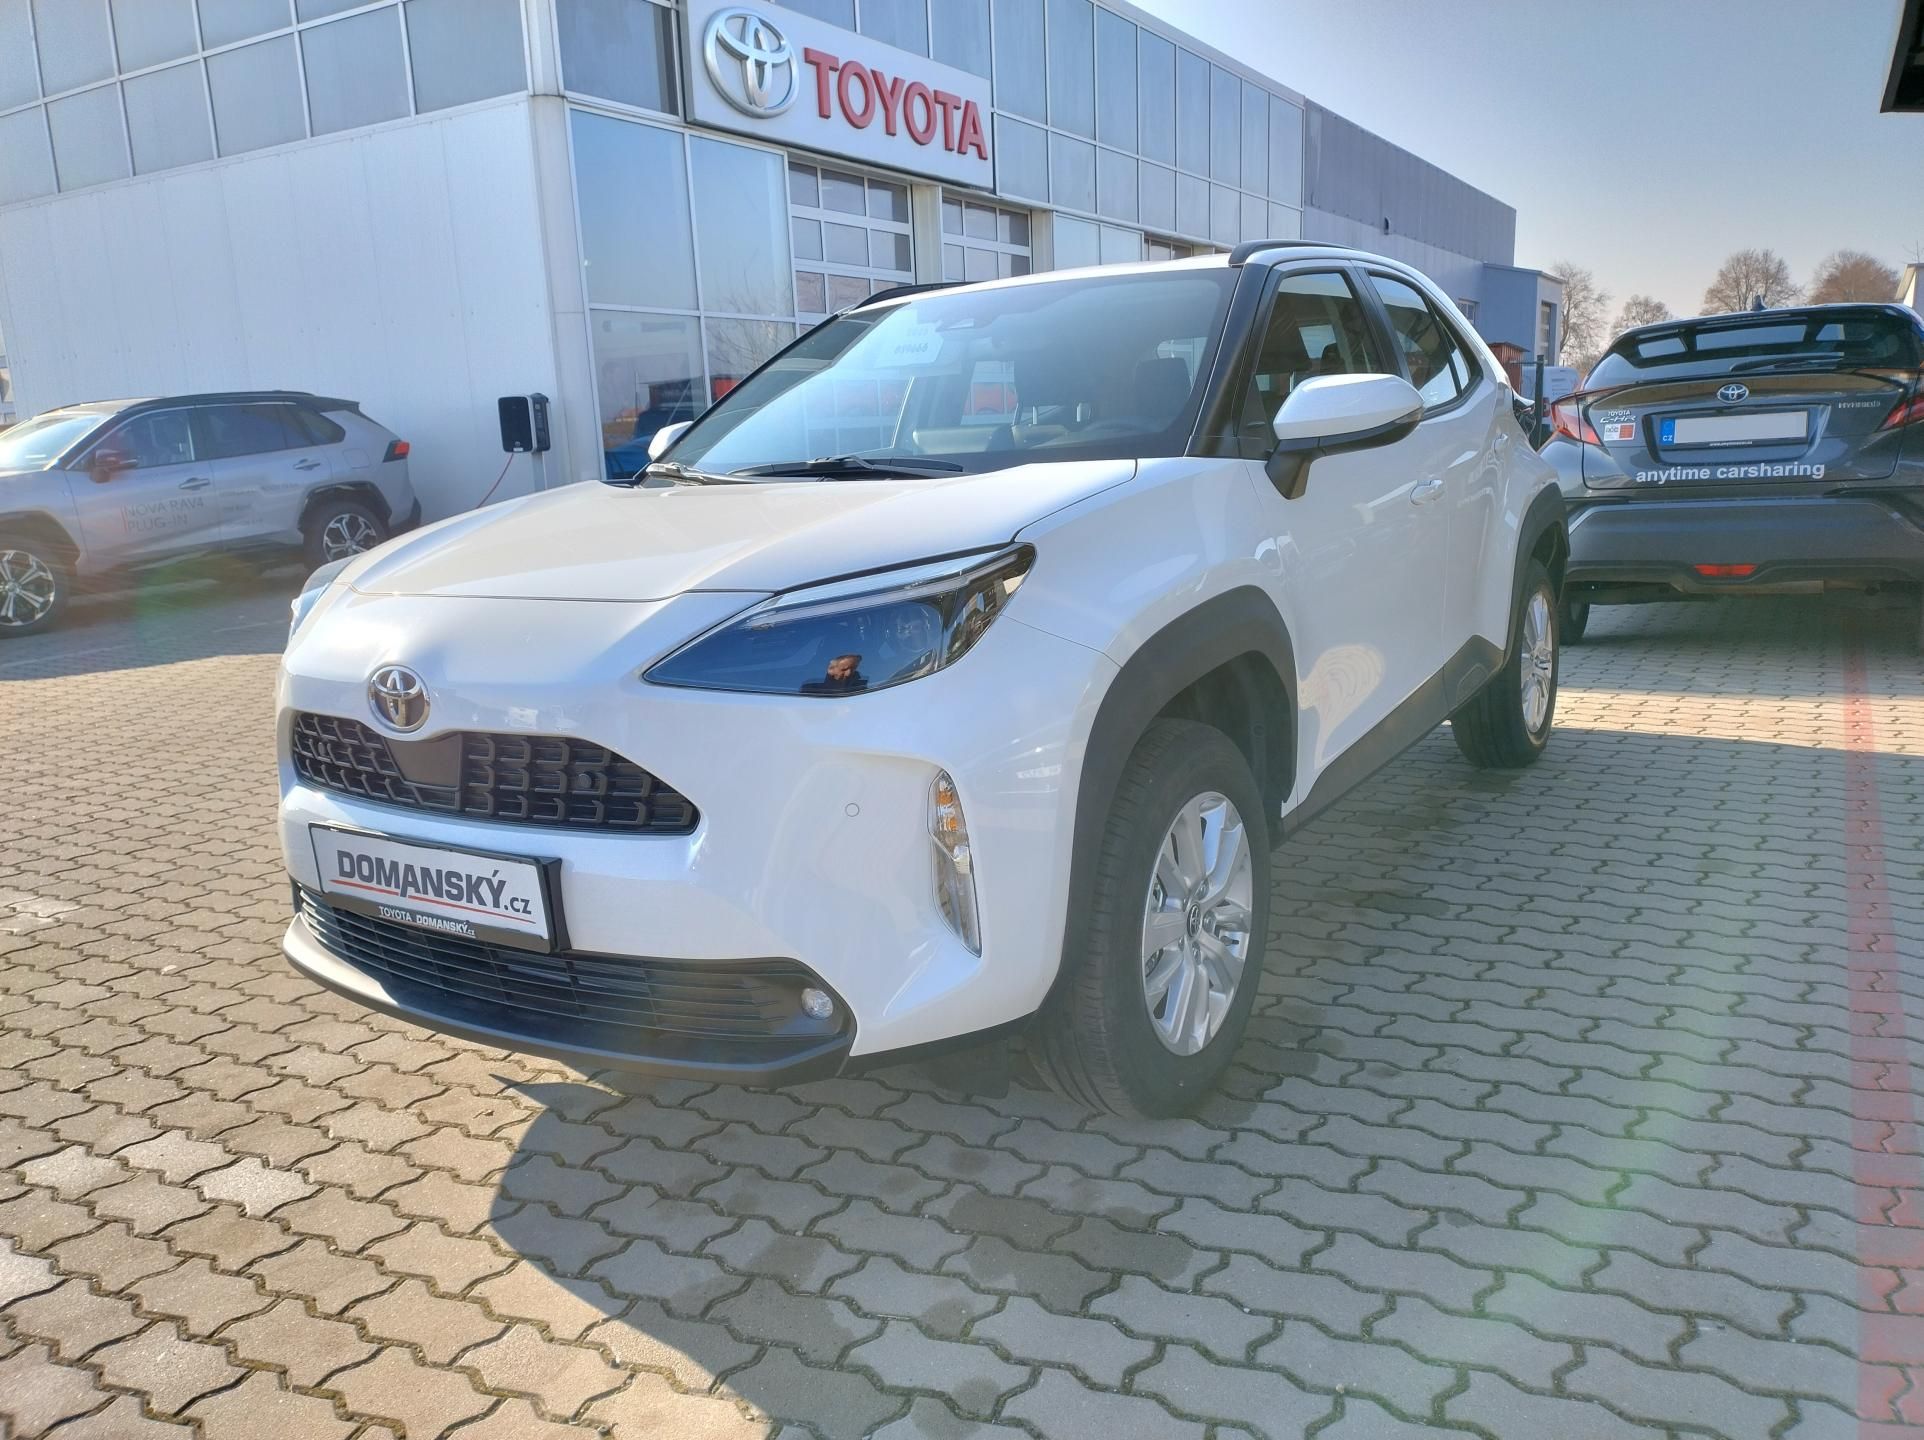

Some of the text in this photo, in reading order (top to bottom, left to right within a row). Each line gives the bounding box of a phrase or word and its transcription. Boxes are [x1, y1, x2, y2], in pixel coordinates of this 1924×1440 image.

[804, 47, 988, 160] TOYOTA
[1636, 461, 1825, 484] anytime carsharing
[123, 497, 205, 517] NOVA RAV4
[128, 514, 188, 531] PLUG-IN
[379, 906, 412, 921] TOYOTA
